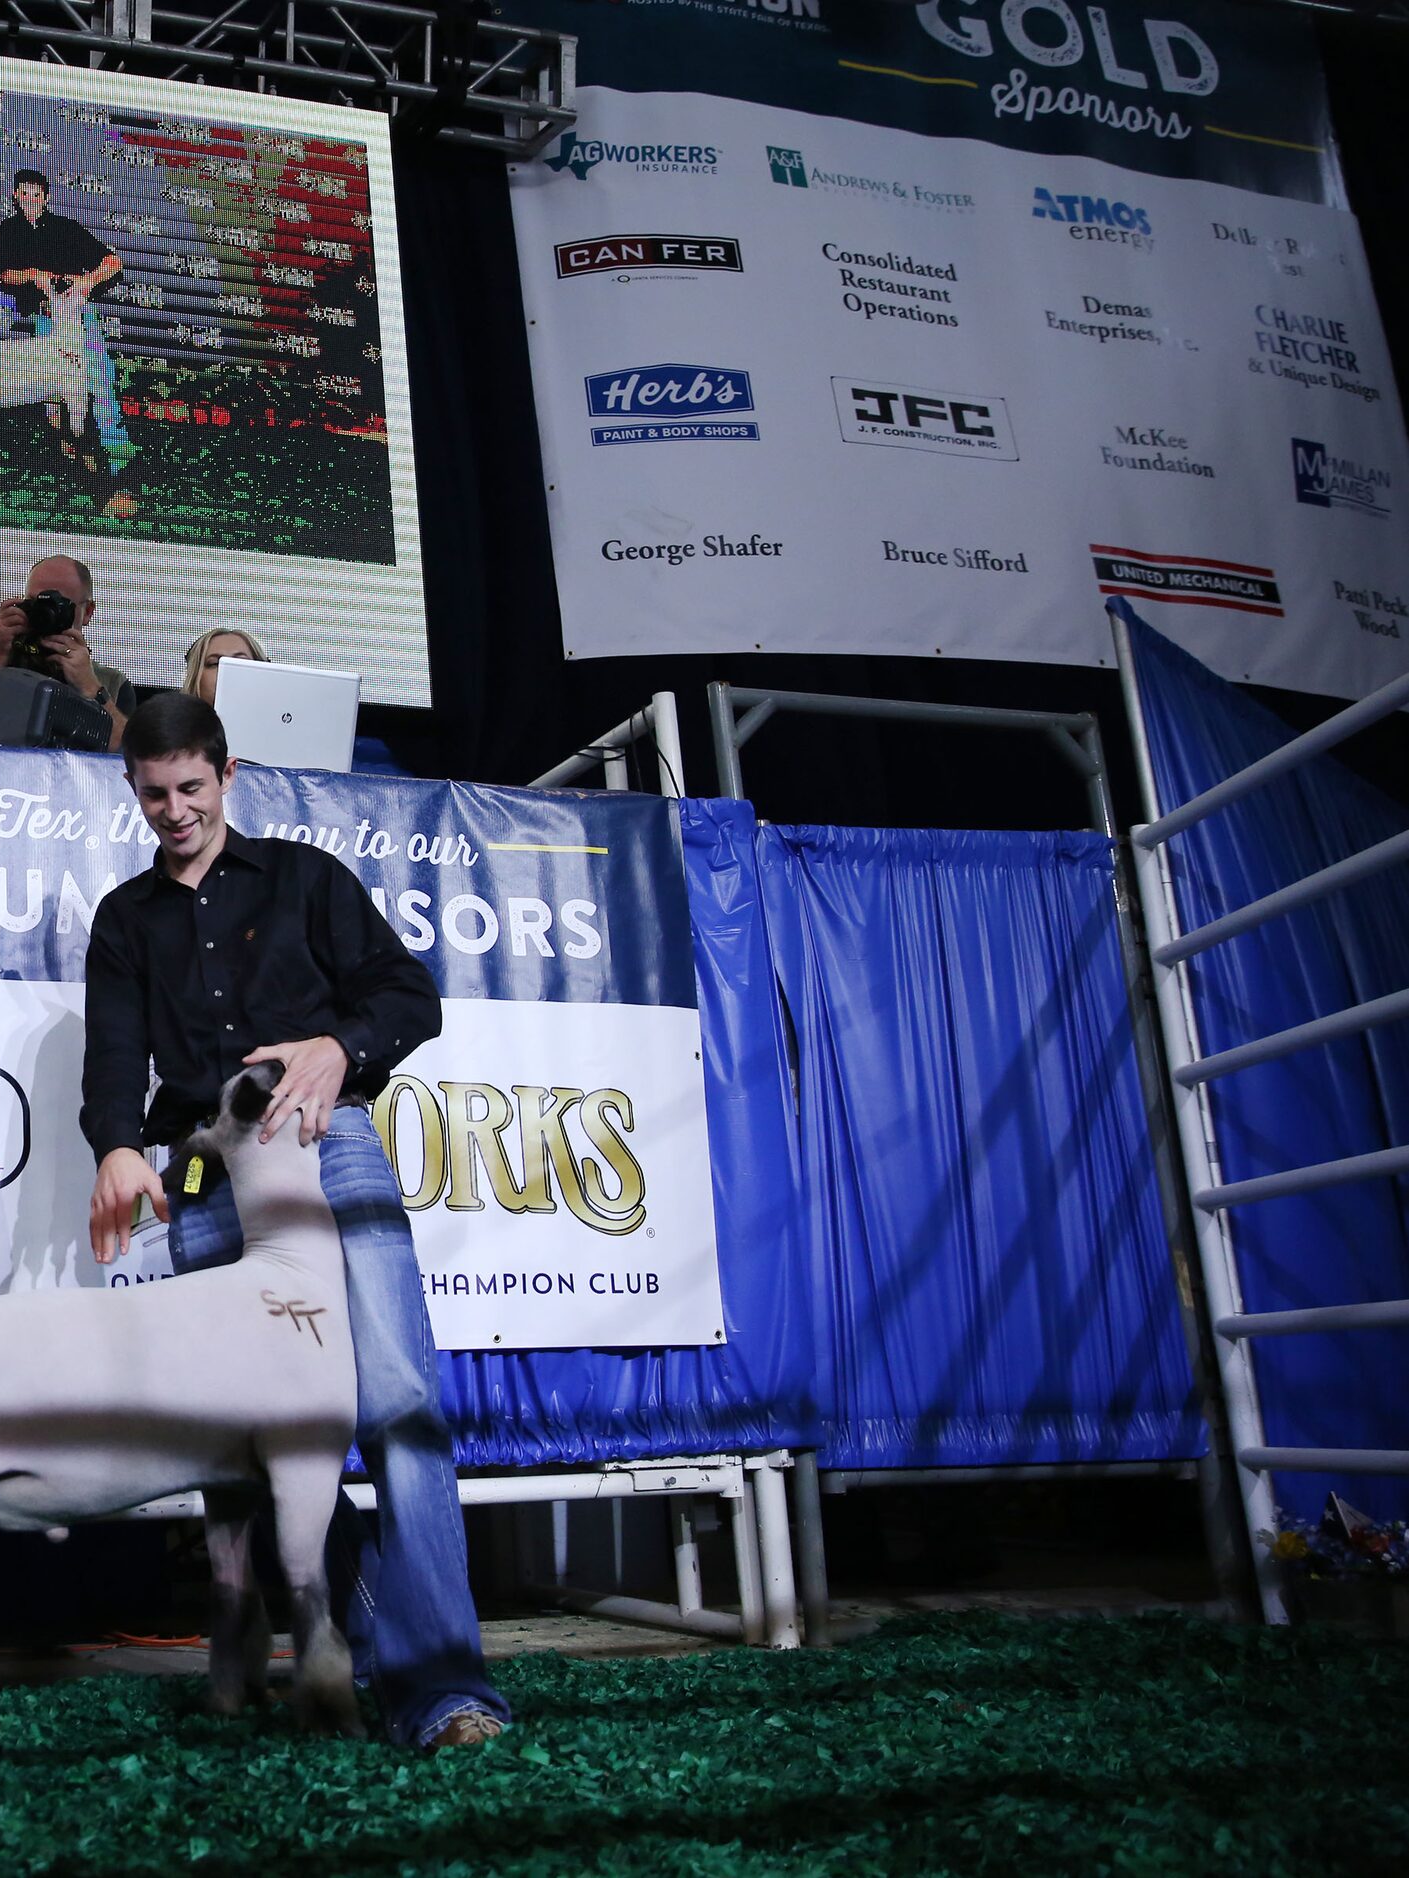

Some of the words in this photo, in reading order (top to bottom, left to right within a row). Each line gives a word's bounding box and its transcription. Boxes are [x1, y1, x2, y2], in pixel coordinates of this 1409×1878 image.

[916, 0, 1219, 96] GOLD
[991, 68, 1191, 140] Sponsors
[636, 164, 718, 175] INSURANCE
[892, 182, 907, 198] &
[1032, 187, 1152, 236] ATMOS
[569, 243, 644, 267] CAN
[662, 243, 727, 262] FER
[822, 243, 958, 282] Consolidated
[839, 268, 951, 303] Restaurant
[843, 292, 959, 327] Operations
[1082, 295, 1153, 318] Demas
[1255, 304, 1349, 344] CHARLIE
[1255, 331, 1361, 375] FLETCHER
[603, 372, 742, 411] Herb's
[1269, 358, 1328, 389] Unique
[1330, 371, 1381, 403] Design
[851, 387, 995, 437] JFC
[603, 429, 644, 441] PAINT
[648, 427, 659, 438] &
[662, 427, 700, 437] BODY
[704, 426, 748, 436] SHOPS
[1115, 425, 1189, 449] McKee
[1100, 445, 1215, 479] Foundation
[601, 539, 695, 566] George
[703, 534, 783, 557] Shafer
[883, 540, 948, 567] Bruce
[953, 547, 1029, 573] Sifford
[1111, 563, 1164, 583] UNITED
[1169, 571, 1265, 597] MECHANICAL
[1353, 609, 1401, 638] Wood
[354, 819, 398, 859] to
[407, 832, 479, 867] our
[589, 1272, 660, 1294] CLUB
